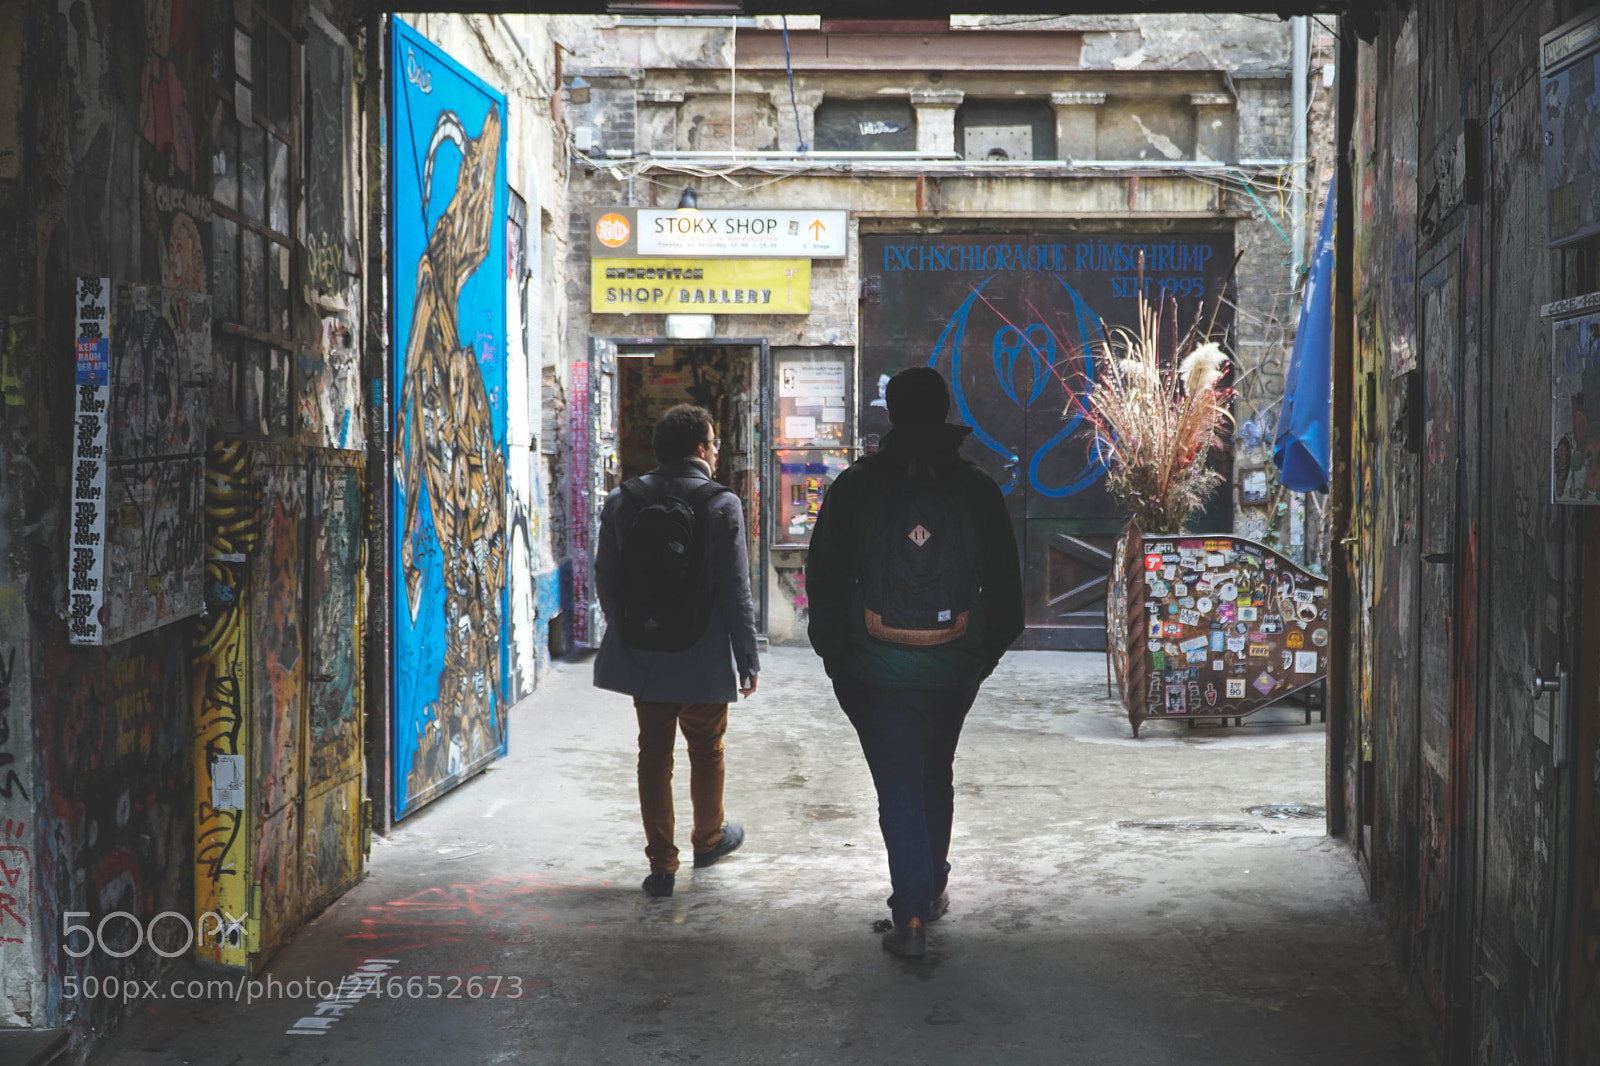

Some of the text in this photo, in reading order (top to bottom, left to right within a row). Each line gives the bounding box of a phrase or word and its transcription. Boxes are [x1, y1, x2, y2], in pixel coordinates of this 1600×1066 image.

[655, 217, 778, 234] STOKX SHOP
[884, 239, 1213, 273] ESCHSCHLORAQUE RÜMSCHRÜMP
[80, 277, 101, 287] TOO
[80, 307, 105, 320] RAP!
[80, 323, 100, 334] TOO
[78, 343, 98, 352] KEIN
[78, 353, 101, 361] RAUM
[77, 363, 92, 372] DER
[79, 391, 94, 401] TO
[80, 400, 105, 412] RAP!
[78, 415, 99, 426] TOO
[78, 425, 101, 438] SHY
[77, 437, 92, 447] TO
[77, 446, 102, 458] RAP!
[76, 467, 99, 479] SHY
[75, 478, 90, 488] TO
[75, 487, 101, 500] RAP!
[75, 502, 95, 513] TOO
[75, 512, 98, 525] SHY
[74, 524, 90, 534] TO
[74, 533, 100, 545] RAP!
[73, 548, 94, 559] TOO
[73, 558, 96, 571] SHY
[72, 569, 88, 580] TO
[72, 579, 98, 591] RAP!
[72, 594, 92, 605] TOO
[72, 604, 94, 616] SHY
[71, 615, 86, 626] TO
[71, 624, 97, 637] RAP!
